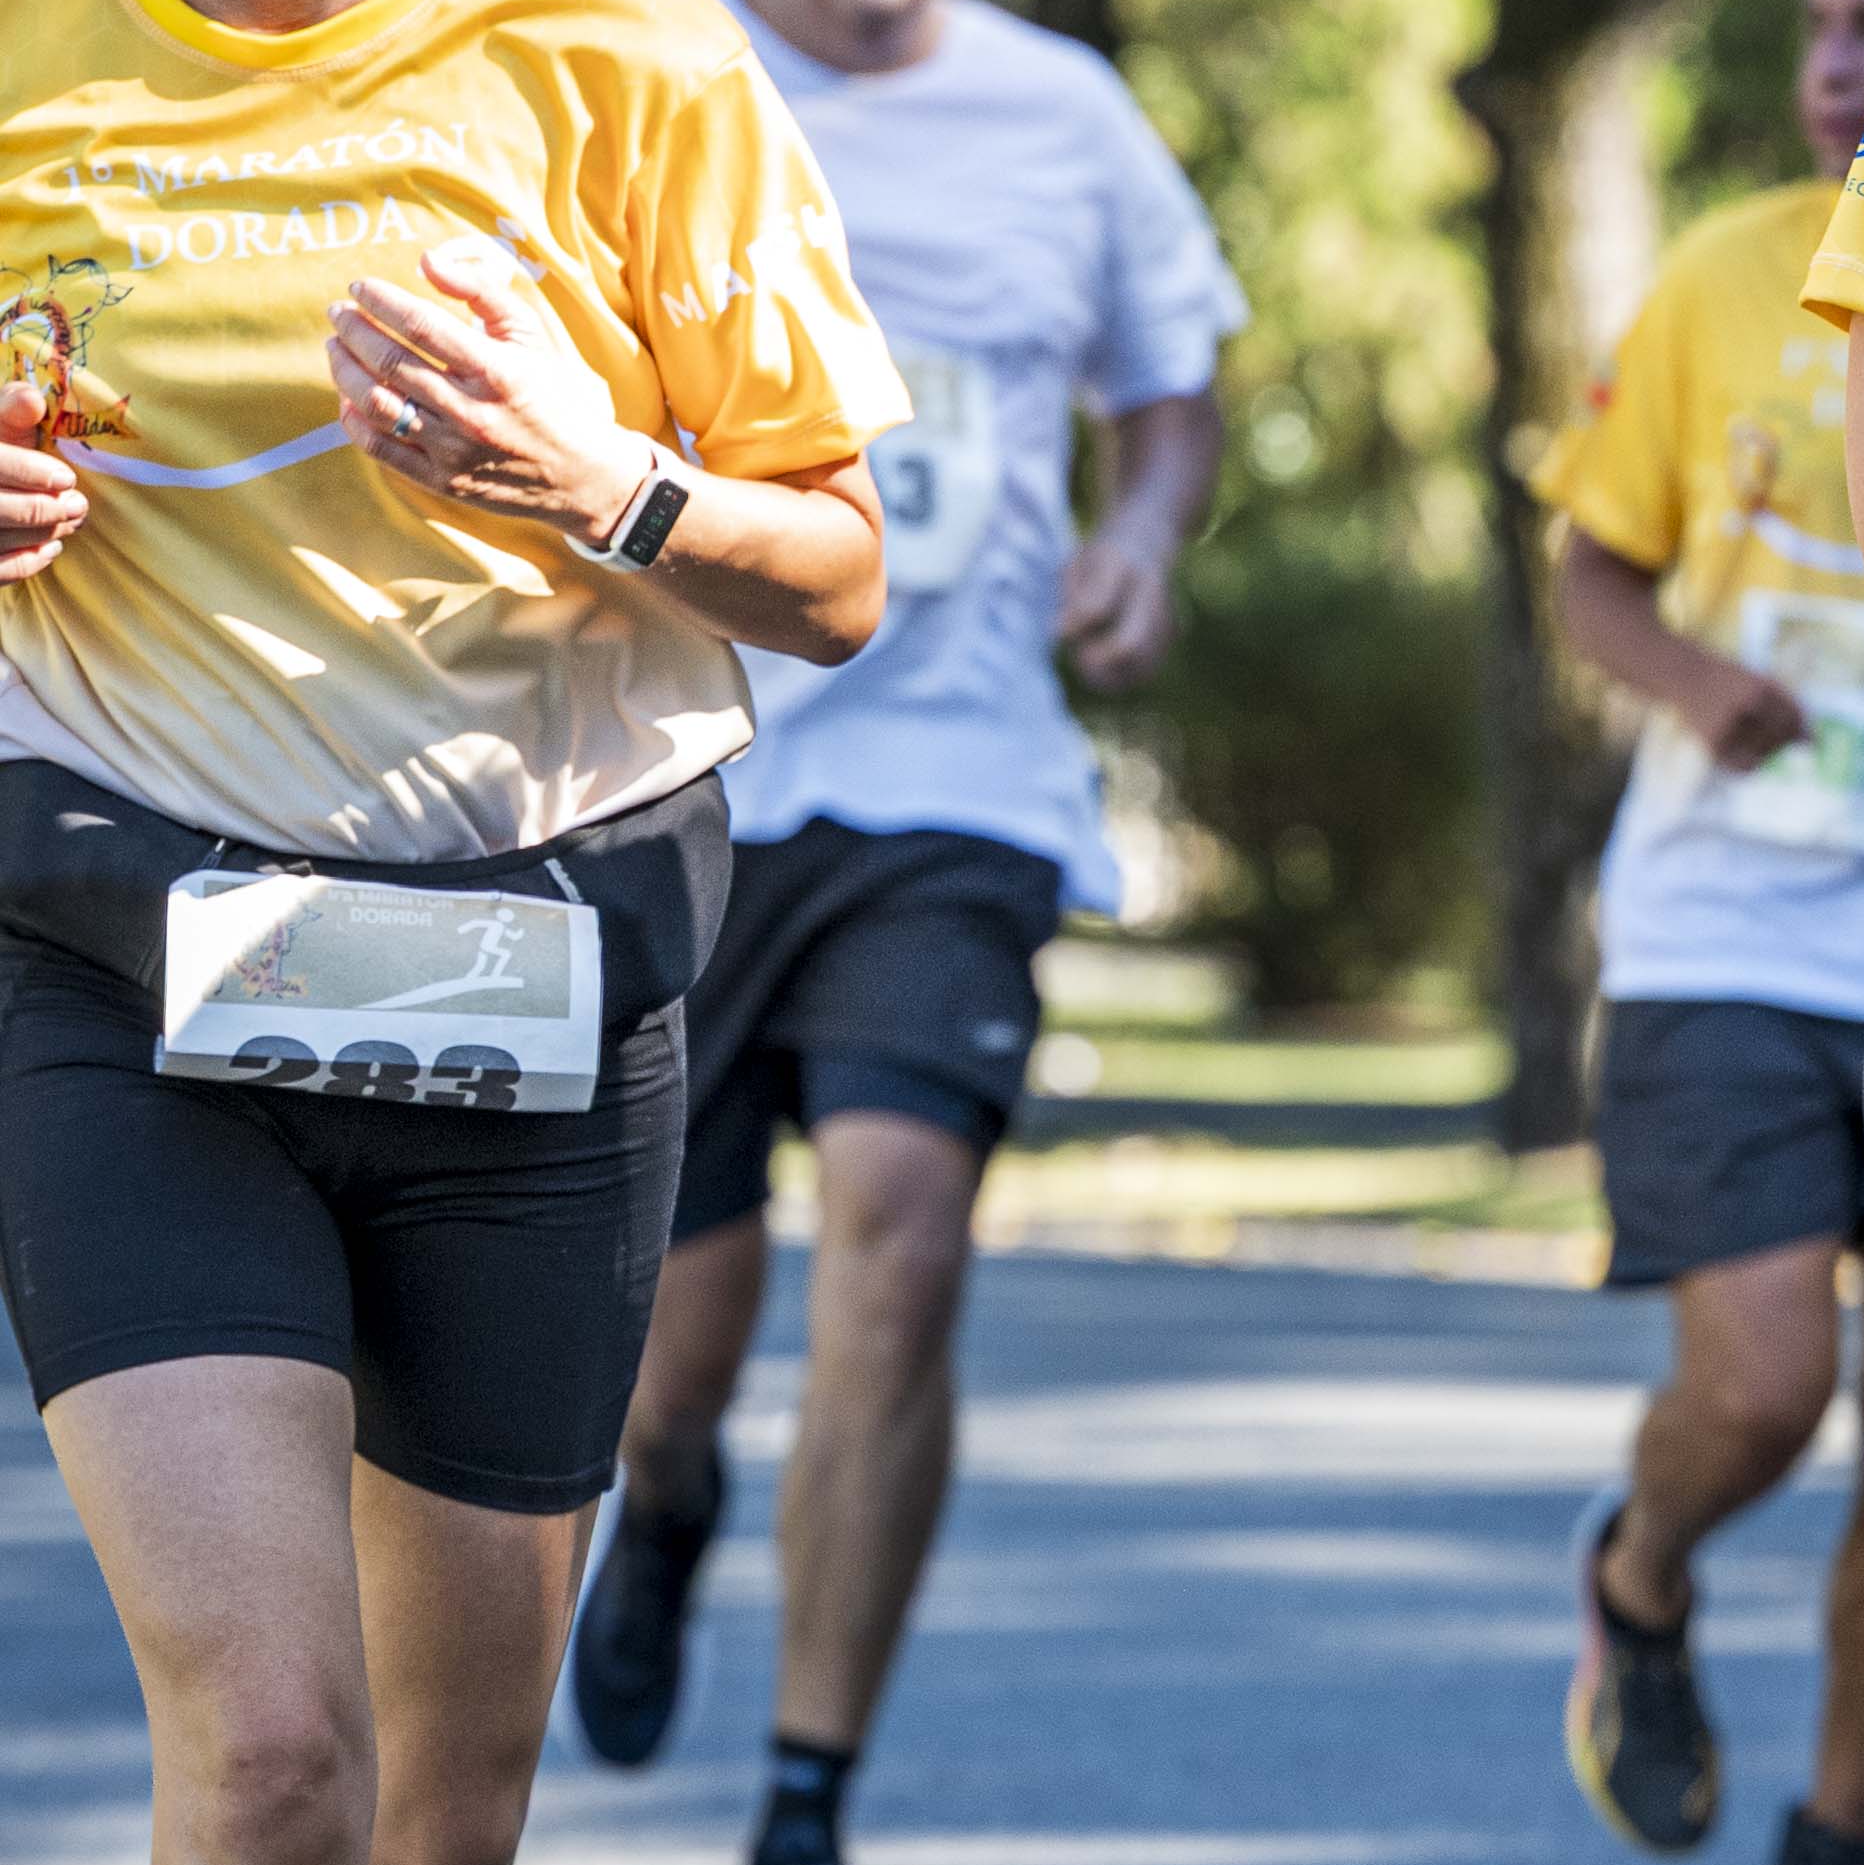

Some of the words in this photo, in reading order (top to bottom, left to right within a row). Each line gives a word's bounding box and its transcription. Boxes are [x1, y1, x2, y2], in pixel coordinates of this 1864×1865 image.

[132, 118, 469, 197] MARATÓN
[122, 194, 419, 272] DORADA
[229, 1035, 522, 1111] 283
